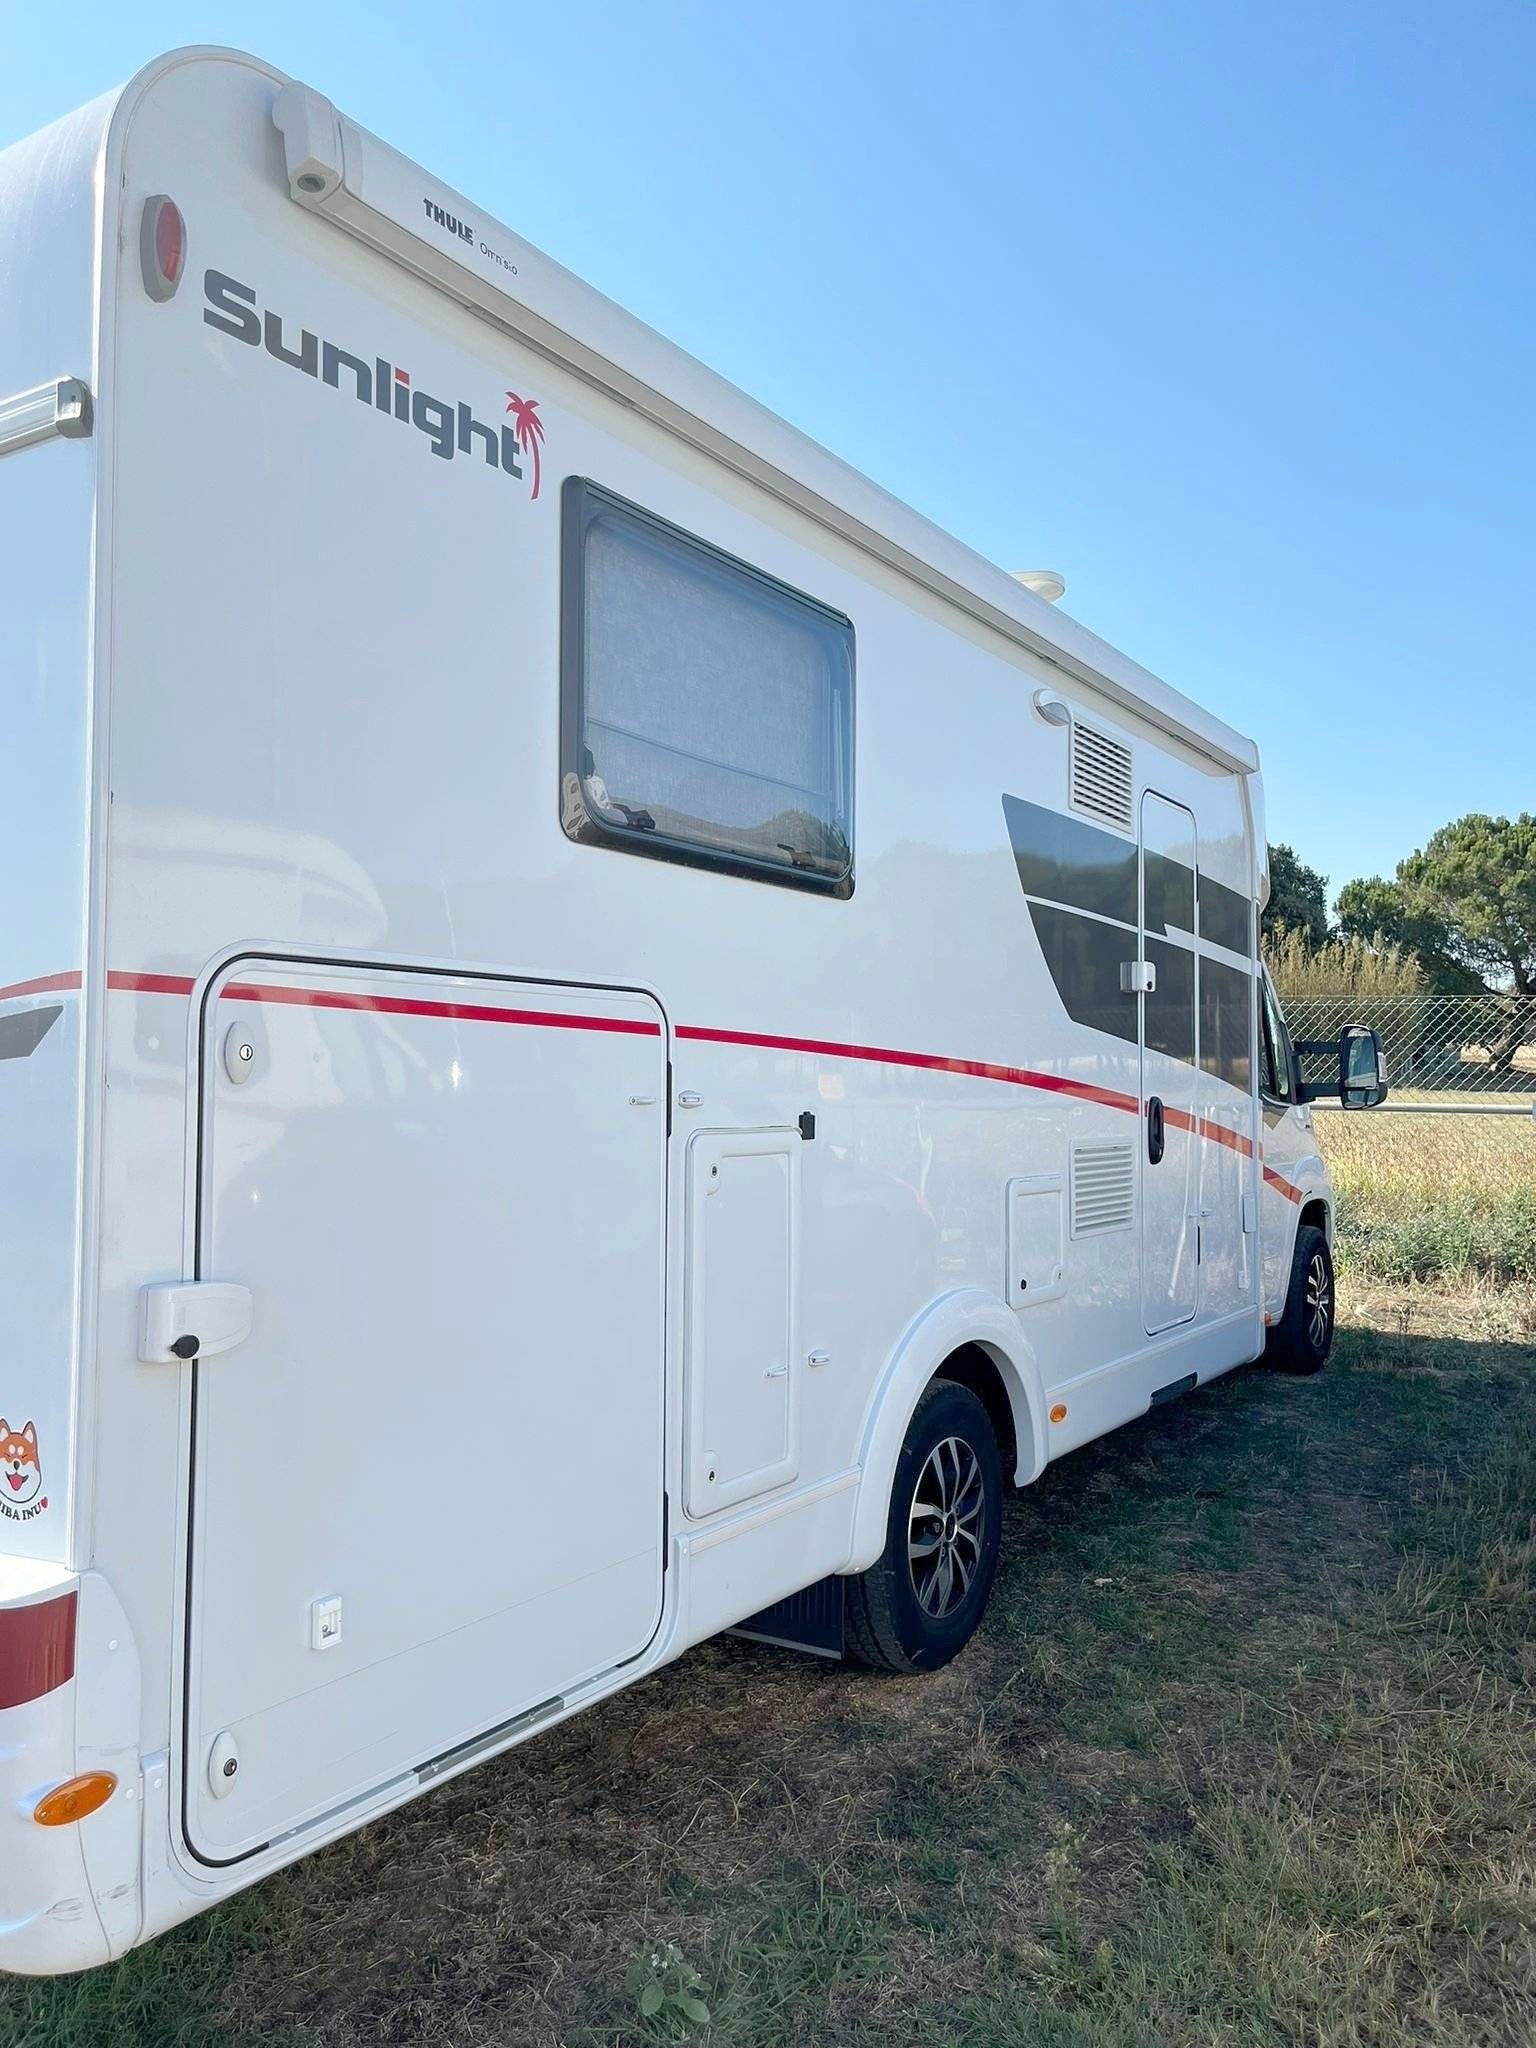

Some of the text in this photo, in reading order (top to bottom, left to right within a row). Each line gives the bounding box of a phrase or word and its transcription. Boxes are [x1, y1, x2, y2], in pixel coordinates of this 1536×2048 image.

[423, 198, 474, 246] THULE
[203, 268, 523, 481] Sunlight
[0, 1501, 42, 1521] IBA INU
